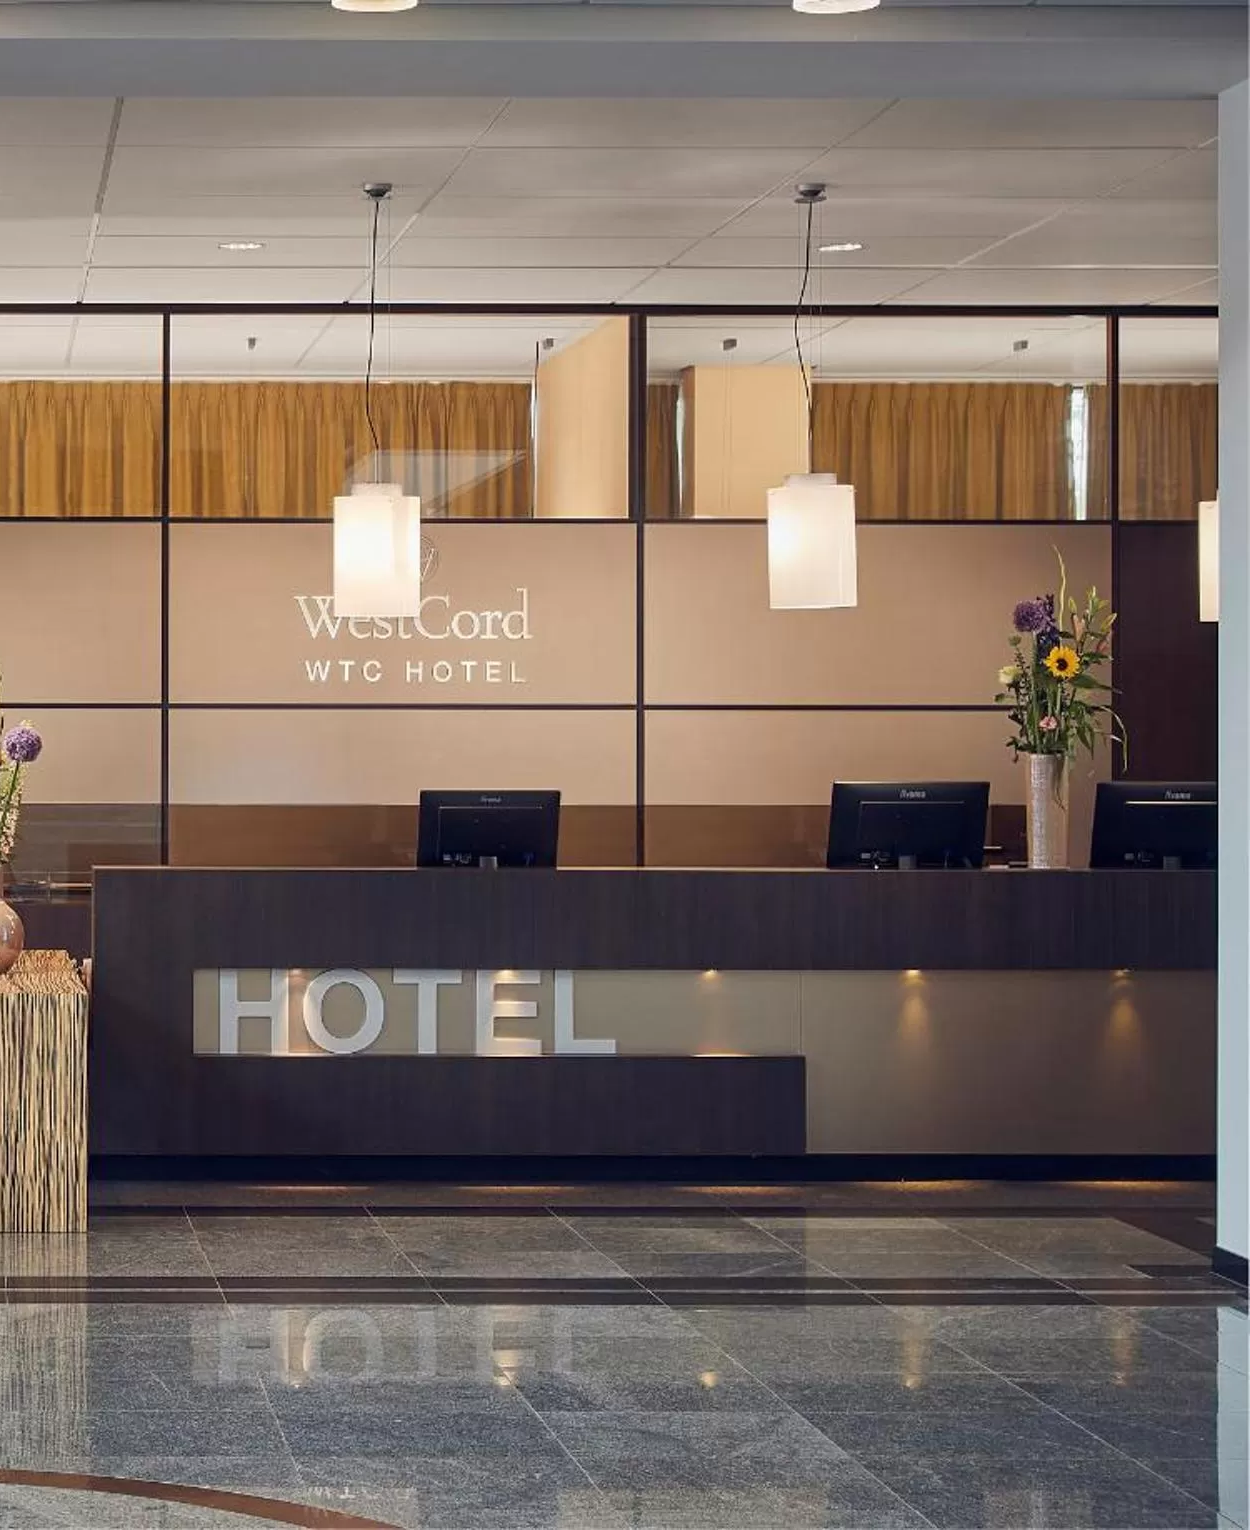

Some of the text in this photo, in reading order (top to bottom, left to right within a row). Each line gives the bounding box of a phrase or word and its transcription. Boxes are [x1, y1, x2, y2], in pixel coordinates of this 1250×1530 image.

[294, 588, 533, 640] WestCord
[305, 660, 526, 683] WTC HOTEL
[219, 968, 617, 1055] HOTEL
